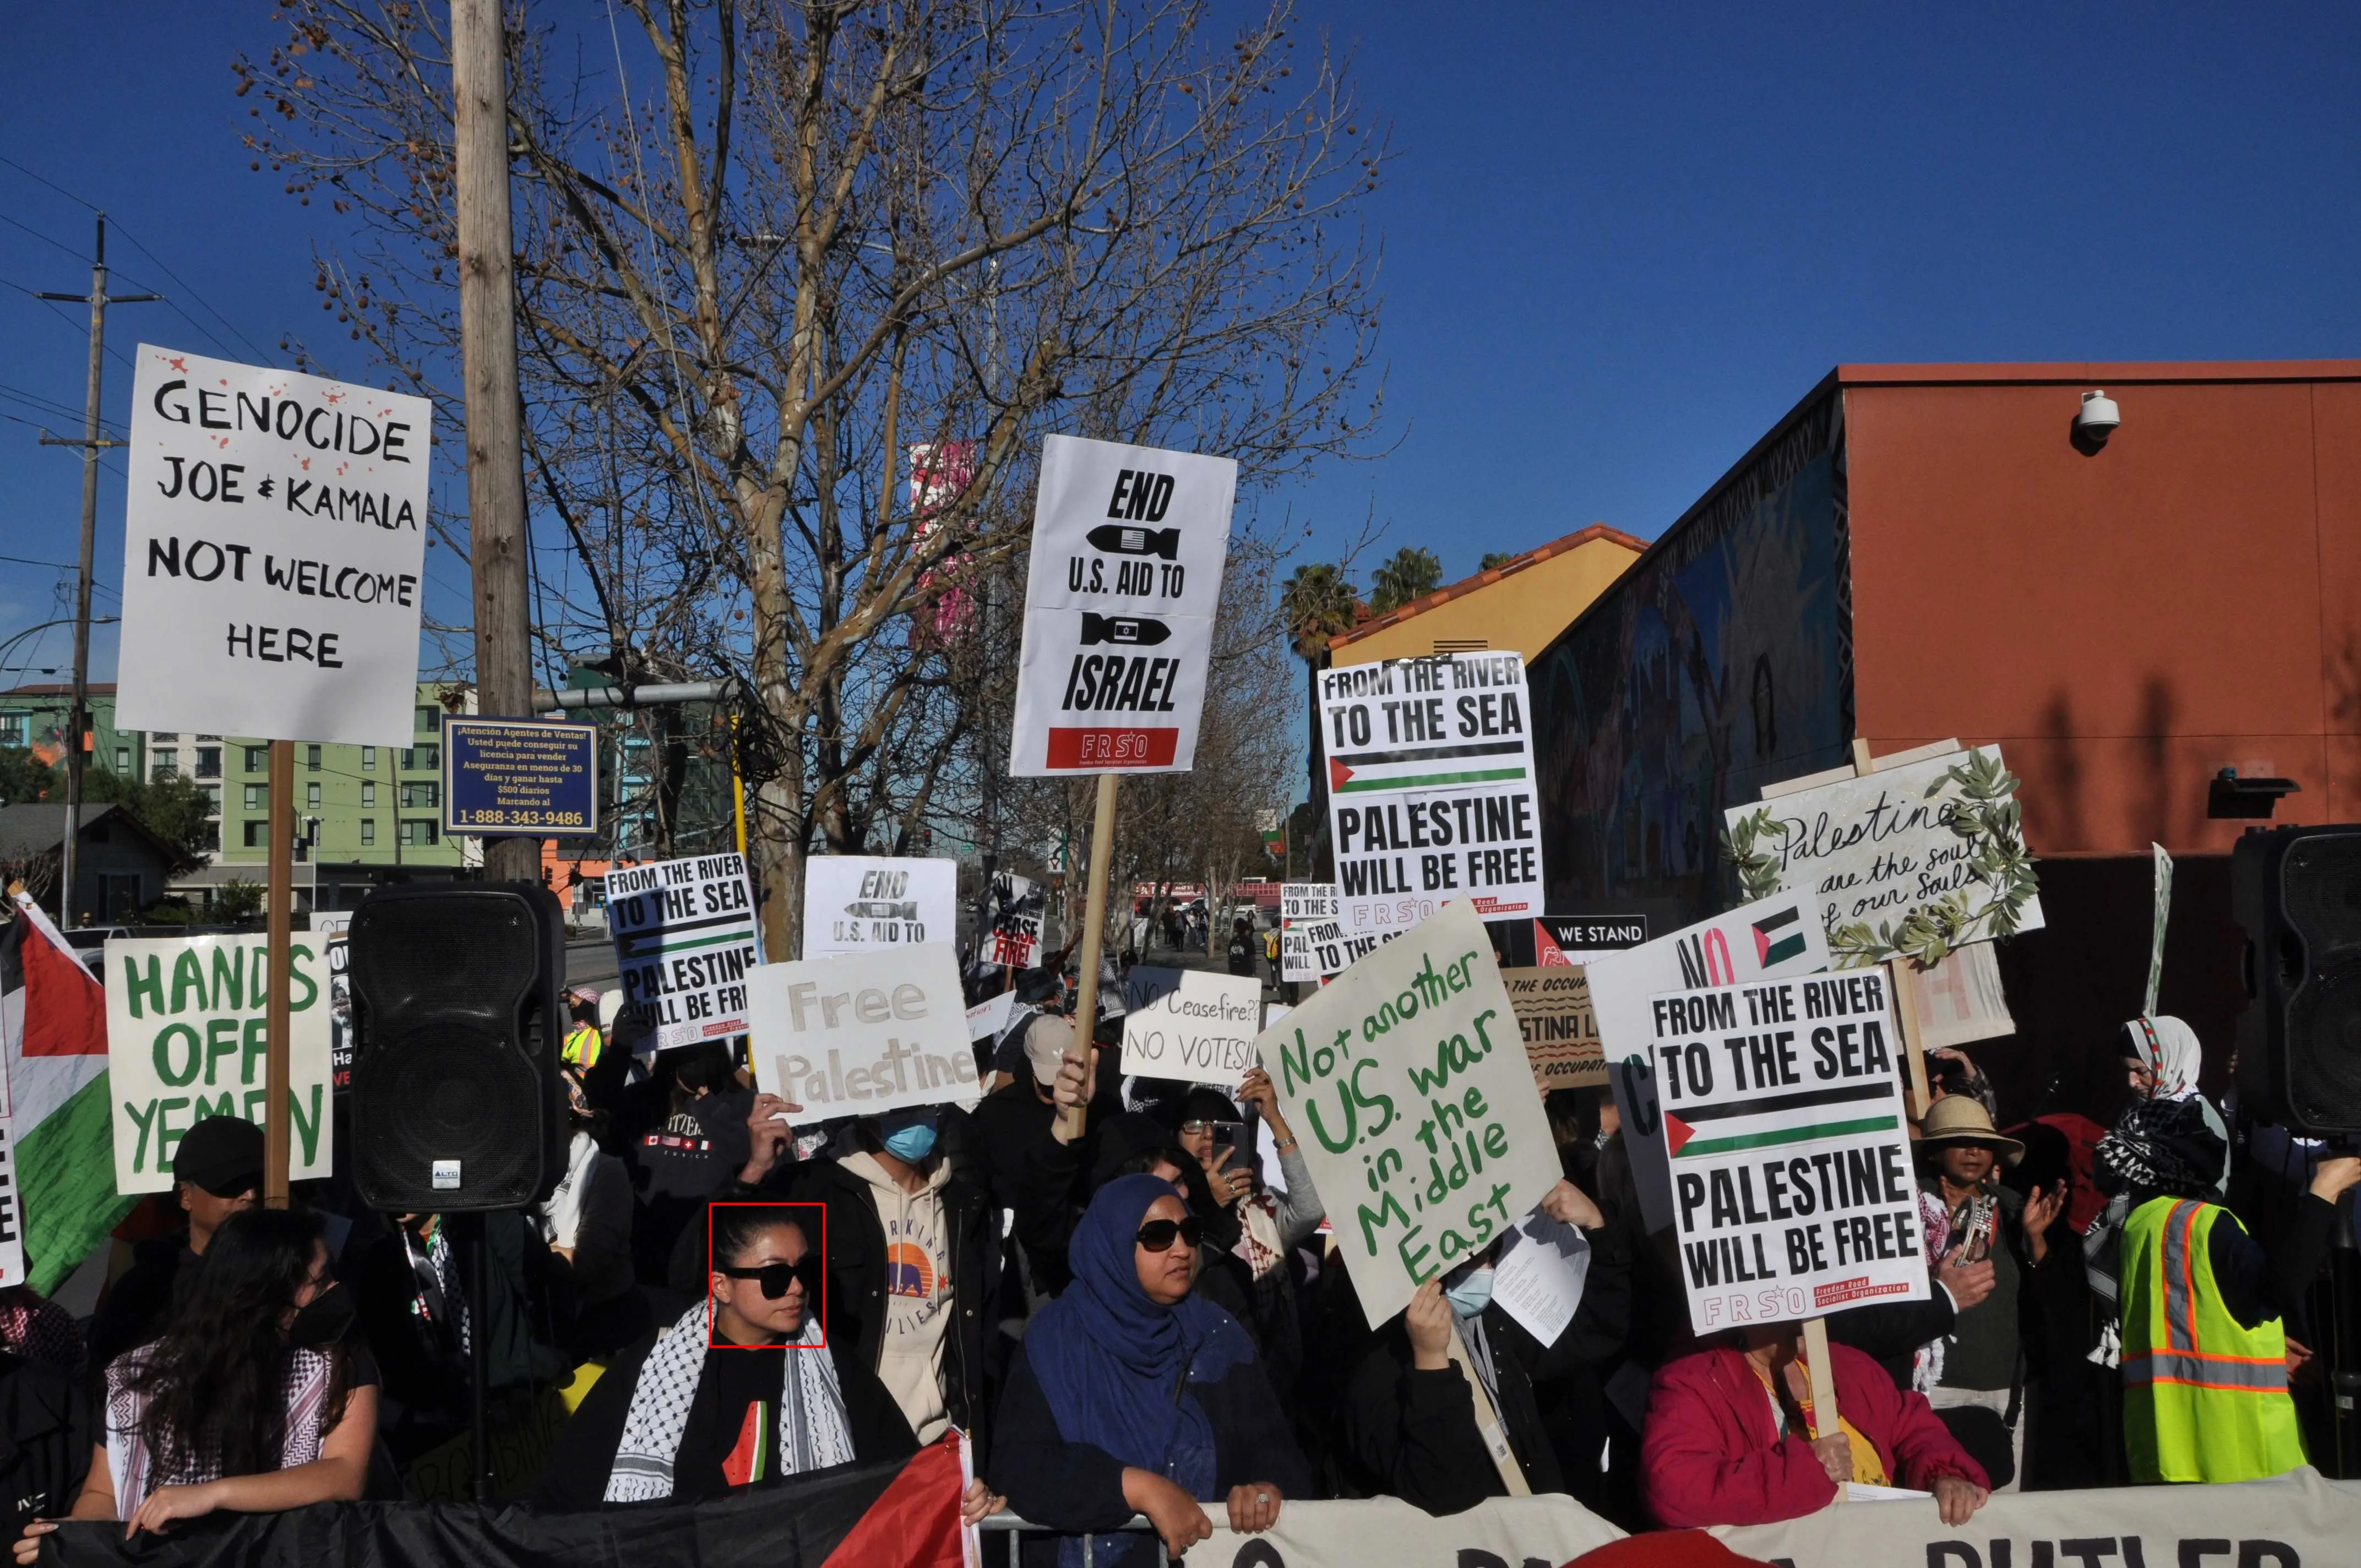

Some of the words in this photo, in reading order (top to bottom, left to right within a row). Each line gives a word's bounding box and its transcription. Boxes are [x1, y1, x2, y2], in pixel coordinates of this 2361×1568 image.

[154, 379, 411, 464] GENOCIDE
[157, 456, 245, 503] JOE
[286, 477, 417, 531] KAMALA
[1107, 469, 1175, 522] END
[148, 536, 252, 582] NOT
[264, 554, 417, 607] WELCOME
[1068, 556, 1108, 594] U.S.
[1116, 560, 1154, 597] AID
[1161, 563, 1184, 599] TO
[227, 623, 343, 668] HERE
[1062, 654, 1180, 712] ISRAEL
[1324, 664, 1393, 700] FROM
[1400, 661, 1445, 692] THE
[1452, 657, 1521, 689] RIVER
[504, 728, 539, 739] Agentes
[541, 729, 552, 738] de
[554, 731, 586, 740] Ventas!
[1328, 704, 1372, 748] TO
[1381, 698, 1447, 743] THE
[1456, 692, 1523, 738] SEA
[467, 738, 493, 747] Usted
[496, 739, 521, 749] puede
[523, 742, 566, 751] conseguir
[480, 750, 514, 759] licencia
[516, 753, 535, 761] para
[537, 752, 567, 761] vender
[1081, 733, 1148, 758] FRSO
[463, 761, 515, 772] Aseguranza
[560, 764, 570, 772] de
[504, 776, 510, 784] y
[512, 775, 536, 784] ganar
[538, 775, 563, 783] hasta
[497, 797, 540, 806] Marcando
[542, 798, 551, 806] al
[498, 785, 518, 794] $500
[520, 786, 550, 794] diarios
[460, 810, 583, 825] 1-888-343-9486
[1337, 793, 1533, 854] PALESTINE
[1772, 791, 1957, 872] Palestine
[607, 867, 659, 895] FROM
[662, 862, 694, 886] THE
[697, 855, 744, 880] RIVER
[858, 869, 909, 899] END
[1340, 857, 1412, 897] WILL
[1421, 853, 1458, 891] BE
[1467, 847, 1537, 886] FREE
[1866, 852, 1918, 884] the
[612, 895, 645, 929] TO
[650, 886, 698, 923] THE
[703, 879, 749, 913] SEA
[1283, 885, 1309, 897] FROM
[1311, 885, 1328, 897] THE
[1284, 899, 1299, 915] TO
[1303, 899, 1326, 915] THE
[1480, 903, 1527, 913] Organization
[1852, 888, 1909, 917] our
[992, 912, 1038, 946] CEASE
[1353, 899, 1434, 926] FRSO
[833, 922, 865, 943] U.S.
[872, 922, 900, 943] AID
[905, 922, 925, 944] TO
[993, 938, 1031, 968] FIRE!
[1558, 925, 1584, 943] WE
[1588, 925, 1644, 943] STAND
[622, 945, 757, 1002] PALESTINE
[1284, 956, 1310, 970] WILL
[1315, 944, 1341, 971] TO
[1130, 981, 1159, 1011] NO
[1168, 987, 1261, 1021] Ceasefire??
[1512, 979, 1539, 992] THE
[1542, 977, 1588, 992] OCCUP
[686, 992, 713, 1021] BE
[788, 981, 929, 1032] Free
[1280, 1028, 1352, 1098] Not
[1363, 951, 1478, 1043] another
[1652, 993, 1737, 1038] FROM
[1743, 984, 1797, 1027] THE
[1803, 975, 1885, 1020] RIVER
[1519, 1015, 1579, 1042] STINA
[1126, 1028, 1165, 1060] NO
[1178, 1034, 1255, 1072] VOTES!!
[1660, 1042, 1715, 1101] TO
[1724, 1030, 1802, 1092] THE
[1810, 1020, 1891, 1080] SEA
[775, 1037, 978, 1106] Palestine
[1305, 1058, 1402, 1154] U.S.
[1407, 1009, 1497, 1097] war
[124, 1084, 323, 1174] YEN
[1362, 1147, 1403, 1193] in
[1415, 1086, 1489, 1155] the
[1357, 1122, 1509, 1257] Middle
[1676, 1144, 1910, 1233] PALESTINE
[1397, 1182, 1512, 1287] East
[1684, 1233, 1777, 1291] WILL
[1785, 1223, 1828, 1276] BE
[1834, 1211, 1919, 1266] FREE
[1704, 1286, 1807, 1326] FRSO
[1816, 1284, 1846, 1297] Freedom
[1848, 1277, 1867, 1289] Road
[1817, 1293, 1849, 1306] Socialist
[1852, 1283, 1908, 1299] Organization
